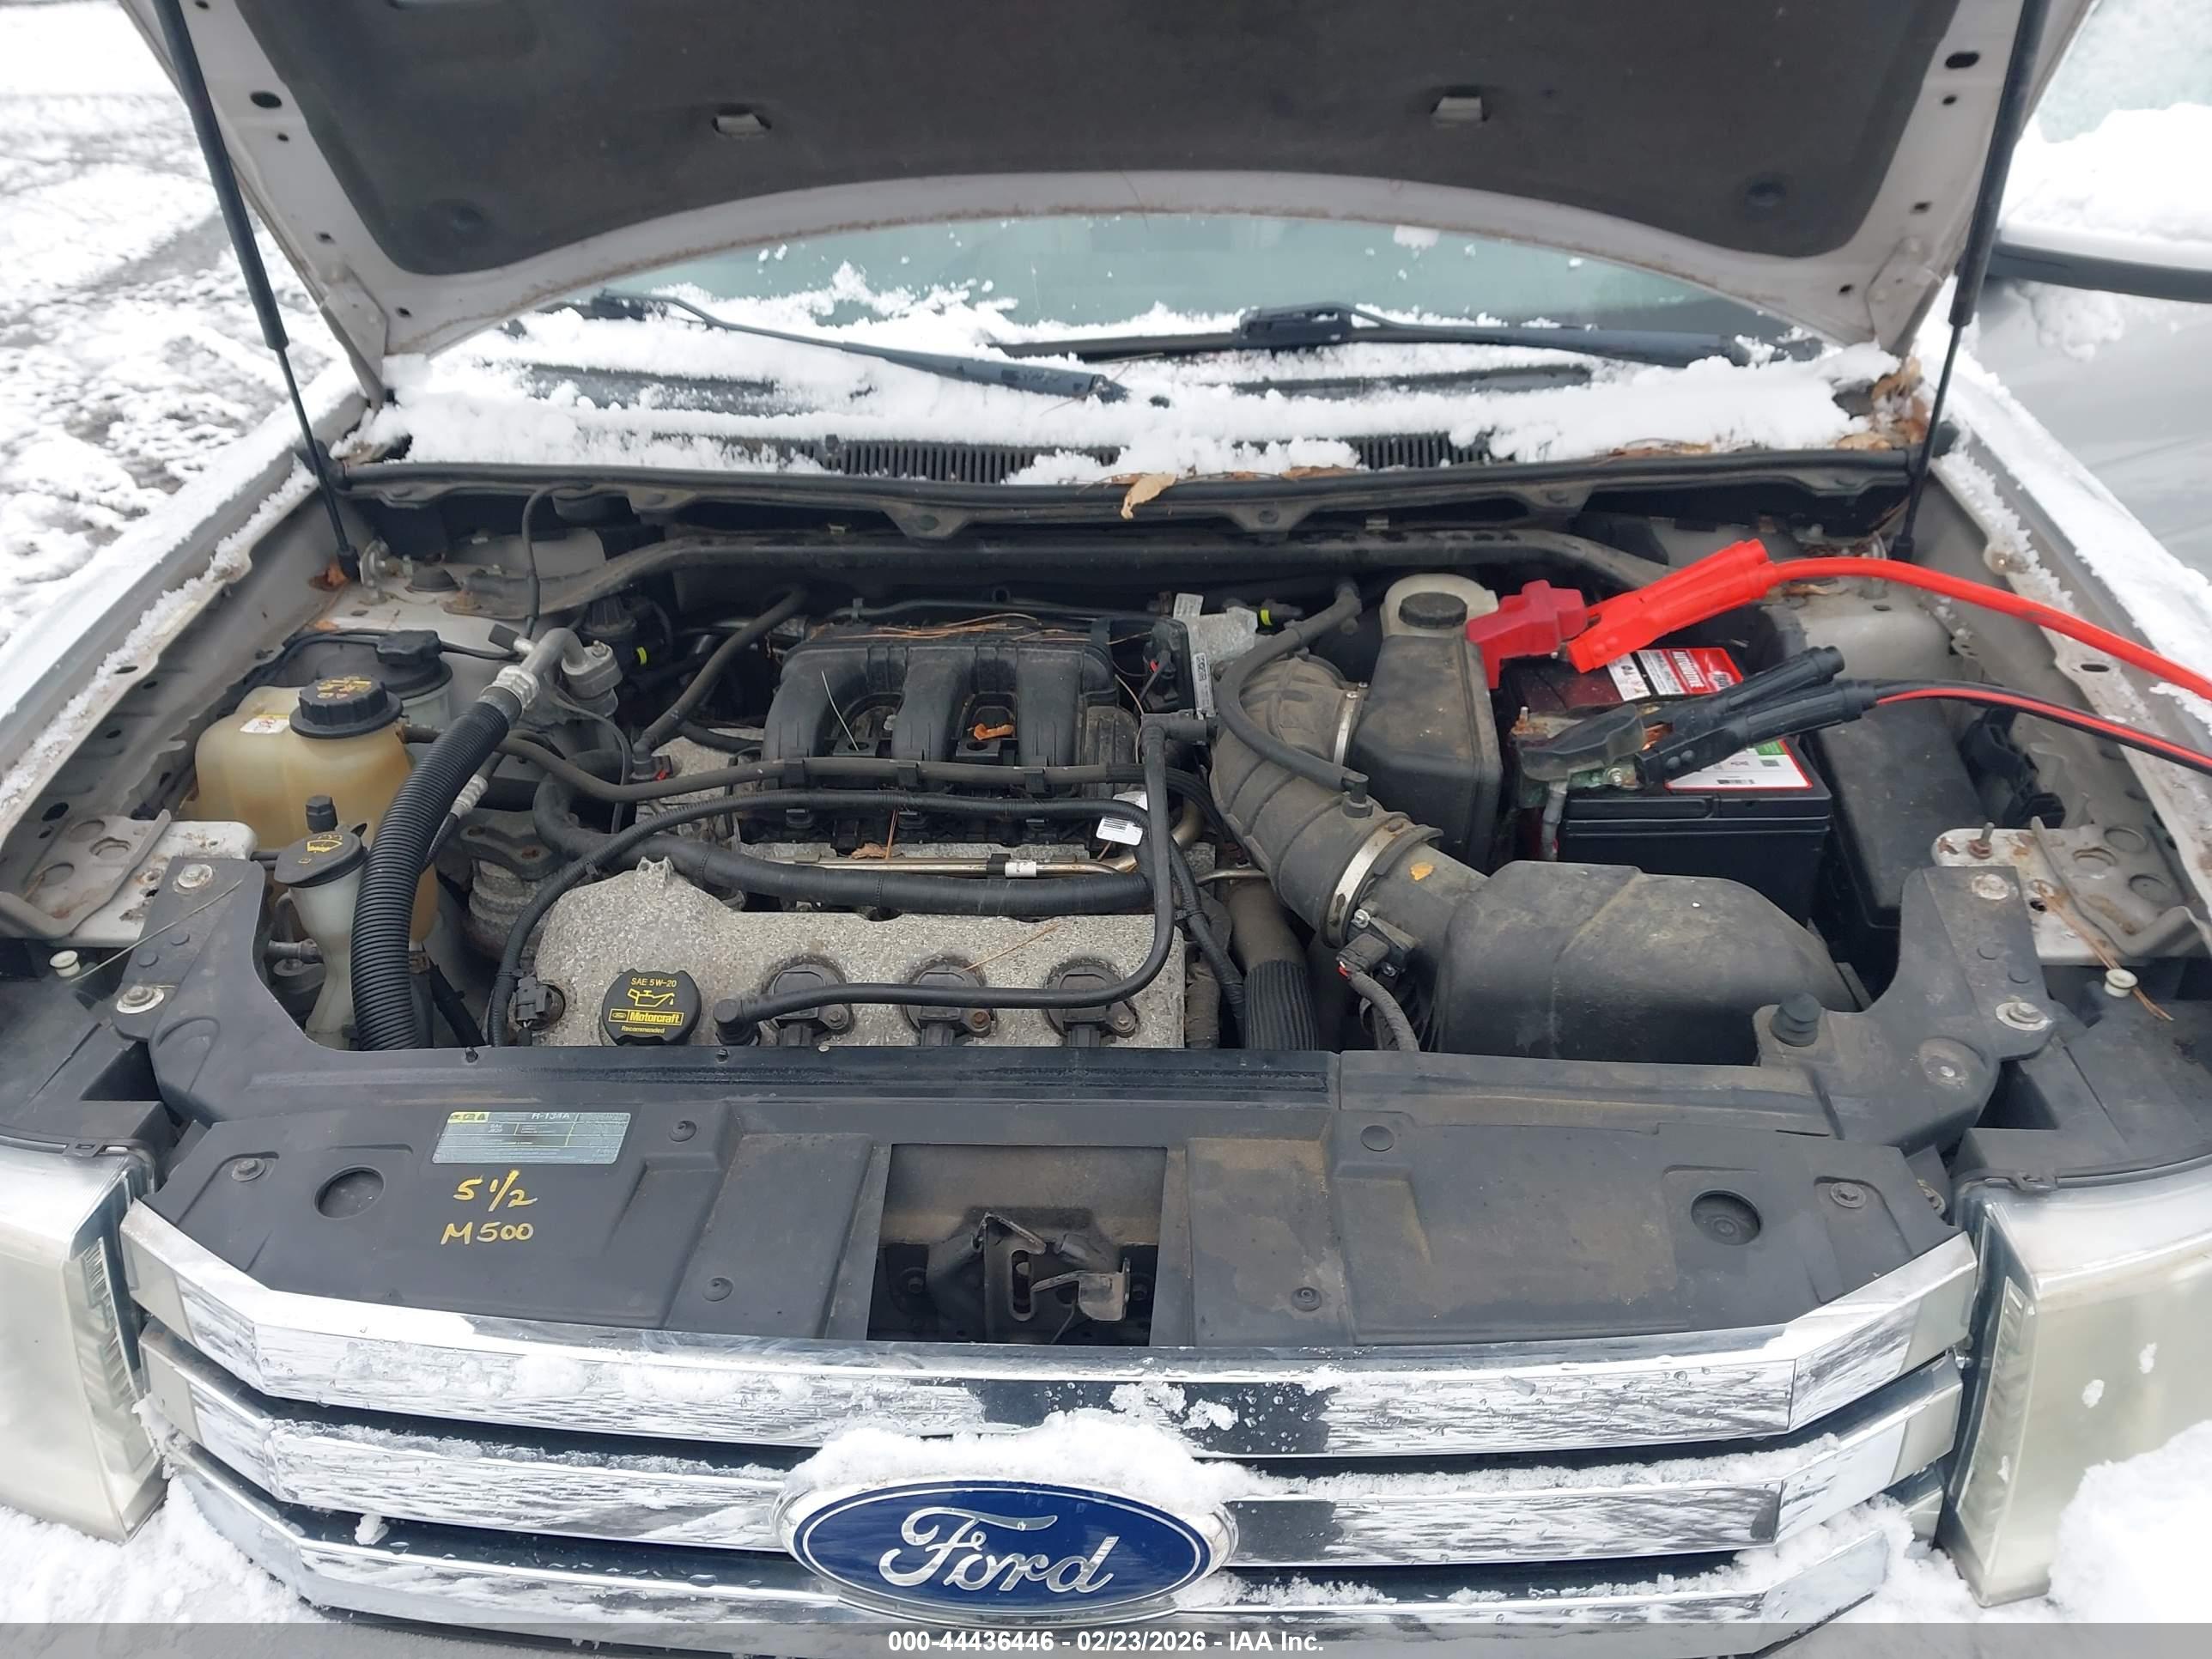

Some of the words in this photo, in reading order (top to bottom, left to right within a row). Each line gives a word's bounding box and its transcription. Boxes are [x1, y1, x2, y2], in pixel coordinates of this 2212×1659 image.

[631, 977, 647, 986] SAE
[649, 979, 677, 988] 5W-20
[629, 1012, 680, 1024] Motorcraft
[621, 1025, 665, 1034] Recommended
[453, 1174, 483, 1200] 5
[878, 1506, 1120, 1593] Ford
